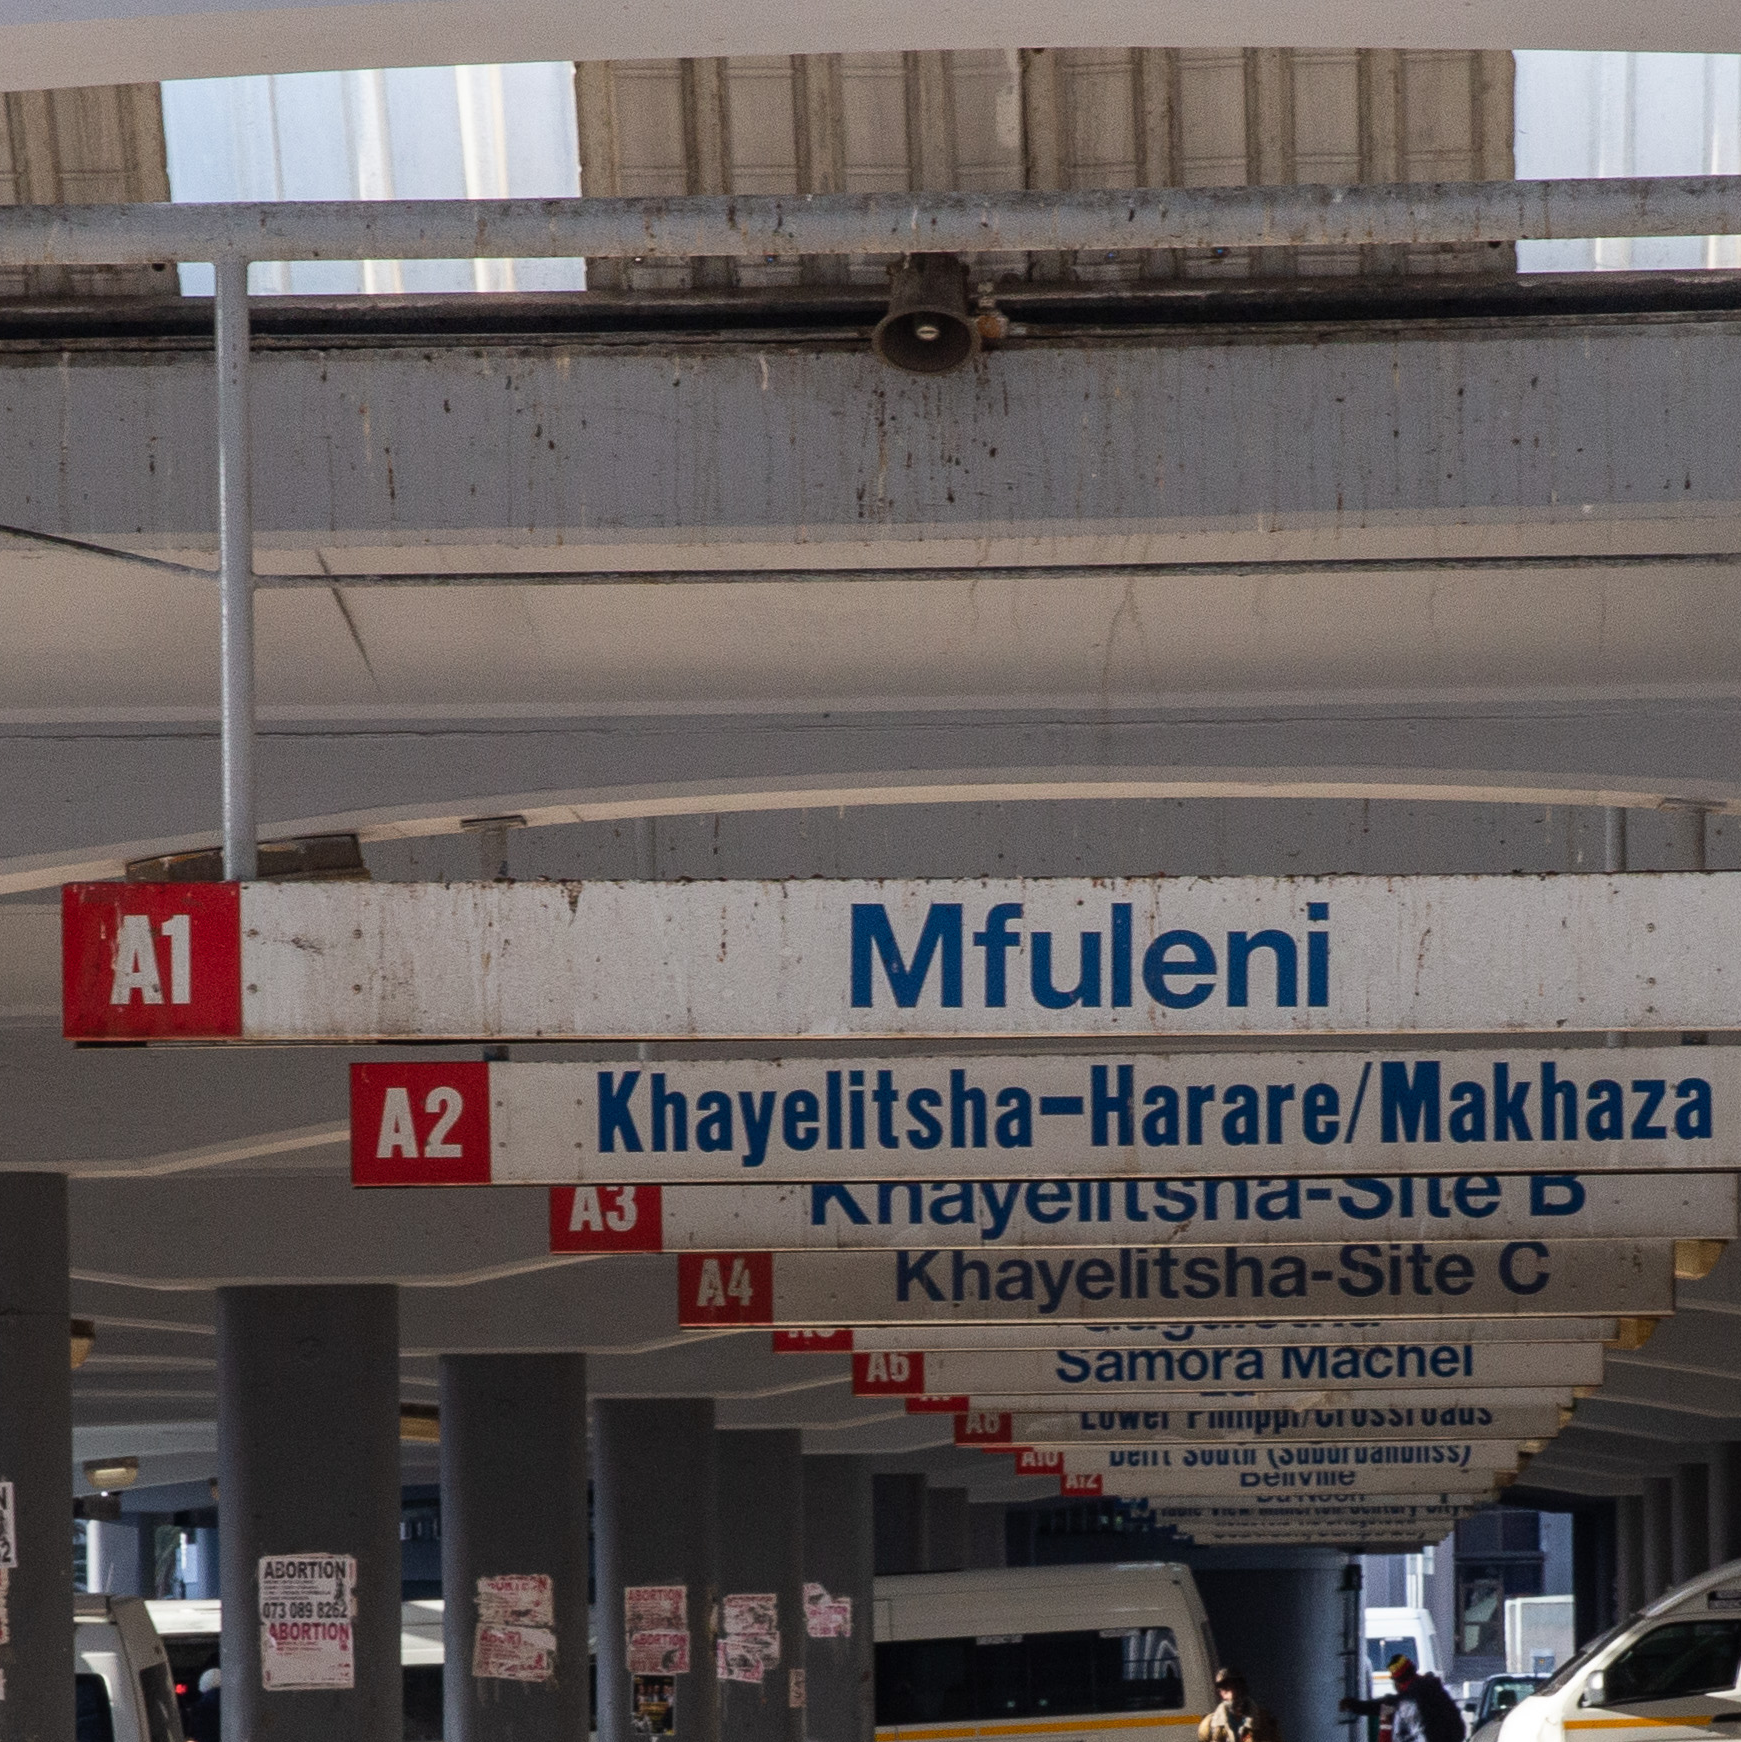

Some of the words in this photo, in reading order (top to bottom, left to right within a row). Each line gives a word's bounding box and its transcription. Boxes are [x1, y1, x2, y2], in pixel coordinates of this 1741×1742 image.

[110, 914, 191, 1005] A1
[850, 902, 1330, 1009] Mfuleni
[376, 1086, 463, 1159] A2
[568, 1185, 639, 1232] A3
[1530, 1173, 1587, 1217] B
[696, 1257, 754, 1308] A4
[895, 1242, 1489, 1314] Khayelitsha-Site
[1498, 1241, 1551, 1296] C
[1057, 1349, 1265, 1385] Samora
[1280, 1344, 1474, 1379] Machel
[264, 1561, 346, 1579] ABORTION
[262, 1602, 287, 1619] 073
[289, 1602, 313, 1618] 089
[316, 1600, 348, 1619] 8262
[269, 1622, 349, 1641] ABORTION
